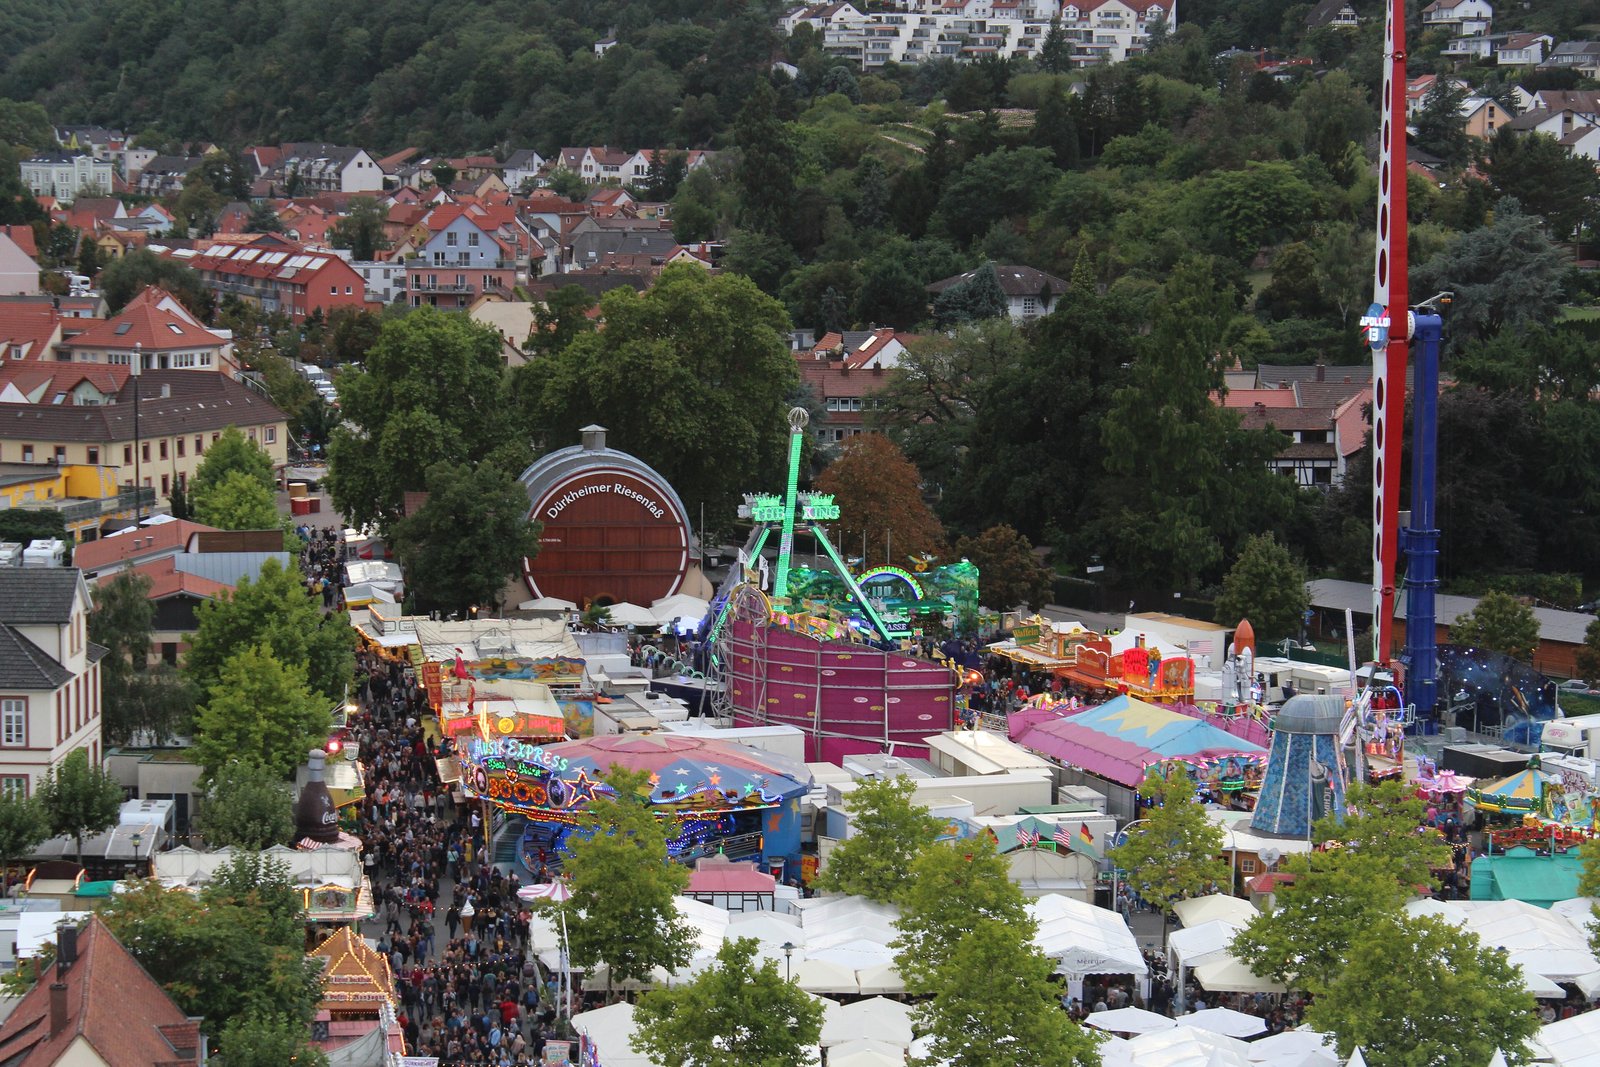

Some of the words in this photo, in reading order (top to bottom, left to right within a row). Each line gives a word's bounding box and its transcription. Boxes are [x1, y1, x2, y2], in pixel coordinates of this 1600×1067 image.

[1360, 316, 1390, 327] APOLLO
[547, 484, 612, 519] Dürkheimer
[614, 483, 665, 519] Riesenfaß
[752, 507, 785, 521] THE
[803, 506, 840, 519] KING
[1012, 627, 1039, 638] Waffeln
[473, 739, 504, 759] MUSIK
[506, 740, 569, 771] EXPRESS
